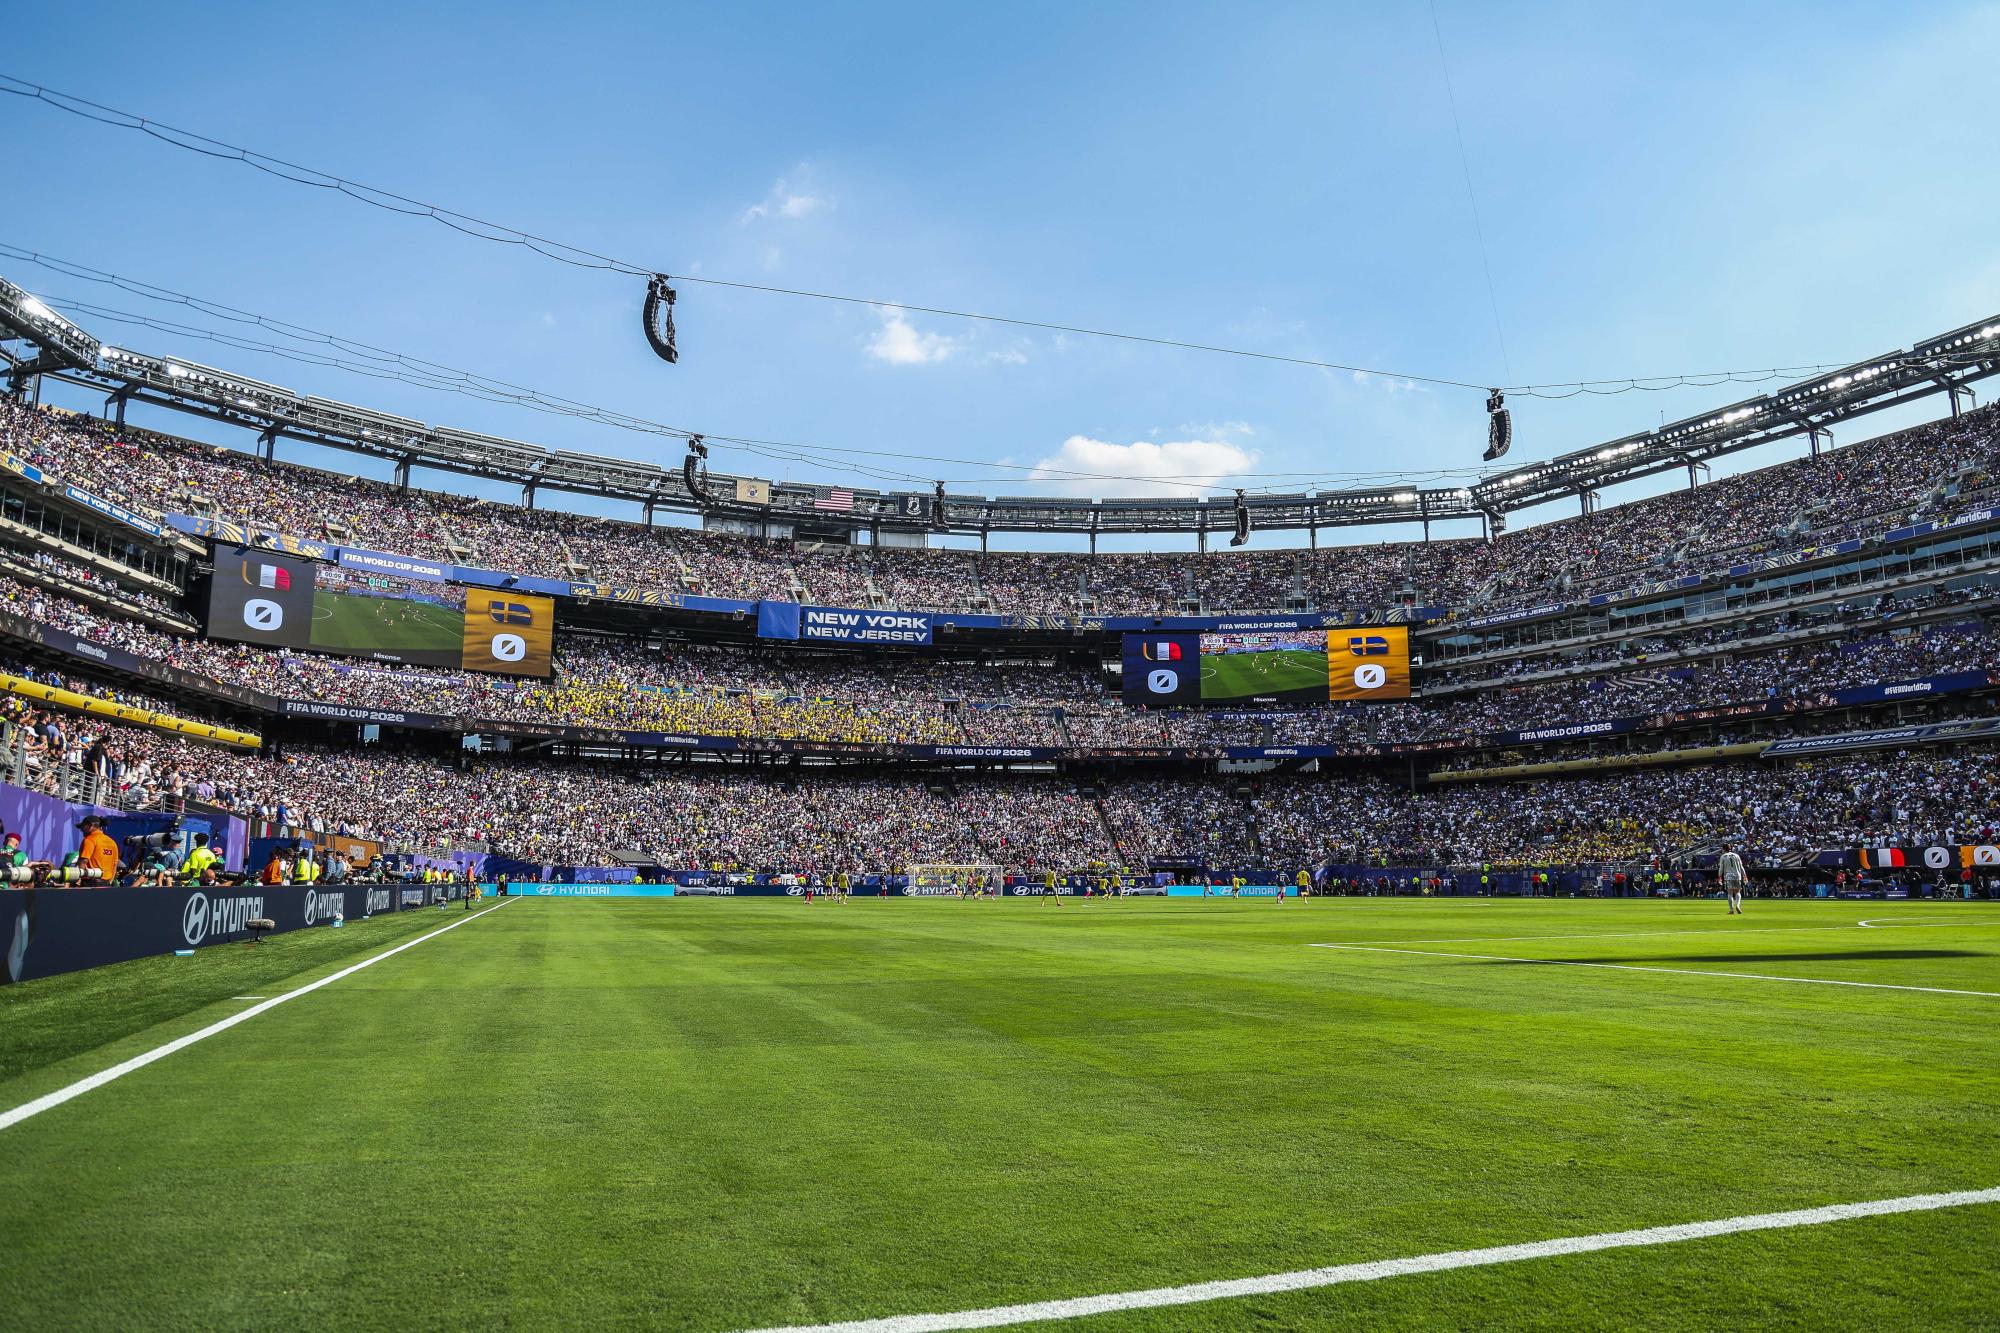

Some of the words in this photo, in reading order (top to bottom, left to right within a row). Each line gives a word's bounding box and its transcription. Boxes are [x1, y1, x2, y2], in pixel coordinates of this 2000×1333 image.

[71, 488, 89, 504] NEW
[90, 497, 112, 512] YORK
[112, 508, 129, 520] NEW
[130, 515, 156, 532] JERSEY
[344, 554, 363, 562] FIFA
[364, 556, 394, 568] WORLD
[394, 562, 412, 570] CUP
[412, 565, 440, 576] 2026
[244, 599, 282, 630] 0
[808, 612, 860, 626] NEW
[865, 616, 928, 629] YORK
[1488, 614, 1509, 622] YORK
[1528, 606, 1559, 615] JERSEY
[808, 626, 850, 638] NEW
[854, 630, 927, 642] JERSEY
[374, 652, 400, 660] Hisense
[492, 634, 526, 662] 0
[351, 668, 370, 677] FIFA
[1148, 670, 1178, 694] 0
[1354, 664, 1386, 688] 0
[1885, 682, 1932, 695] #FIFAWorldCup
[286, 702, 309, 712] FIFA
[310, 704, 348, 716] WORLD
[348, 710, 368, 718] CUP
[370, 712, 405, 722] 2026
[1520, 732, 1536, 740] FIFA
[1536, 728, 1565, 738] WORLD
[1566, 726, 1582, 734] CUP
[1582, 722, 1612, 734] 2026
[1802, 738, 1844, 746] WORLD
[1870, 730, 1917, 740] 2026
[954, 748, 984, 756] WORLD
[1924, 846, 1950, 868] 0
[560, 886, 610, 894] HYUNDAI
[318, 892, 344, 919] HYUNDAI
[212, 896, 264, 935] HYUNDAI
